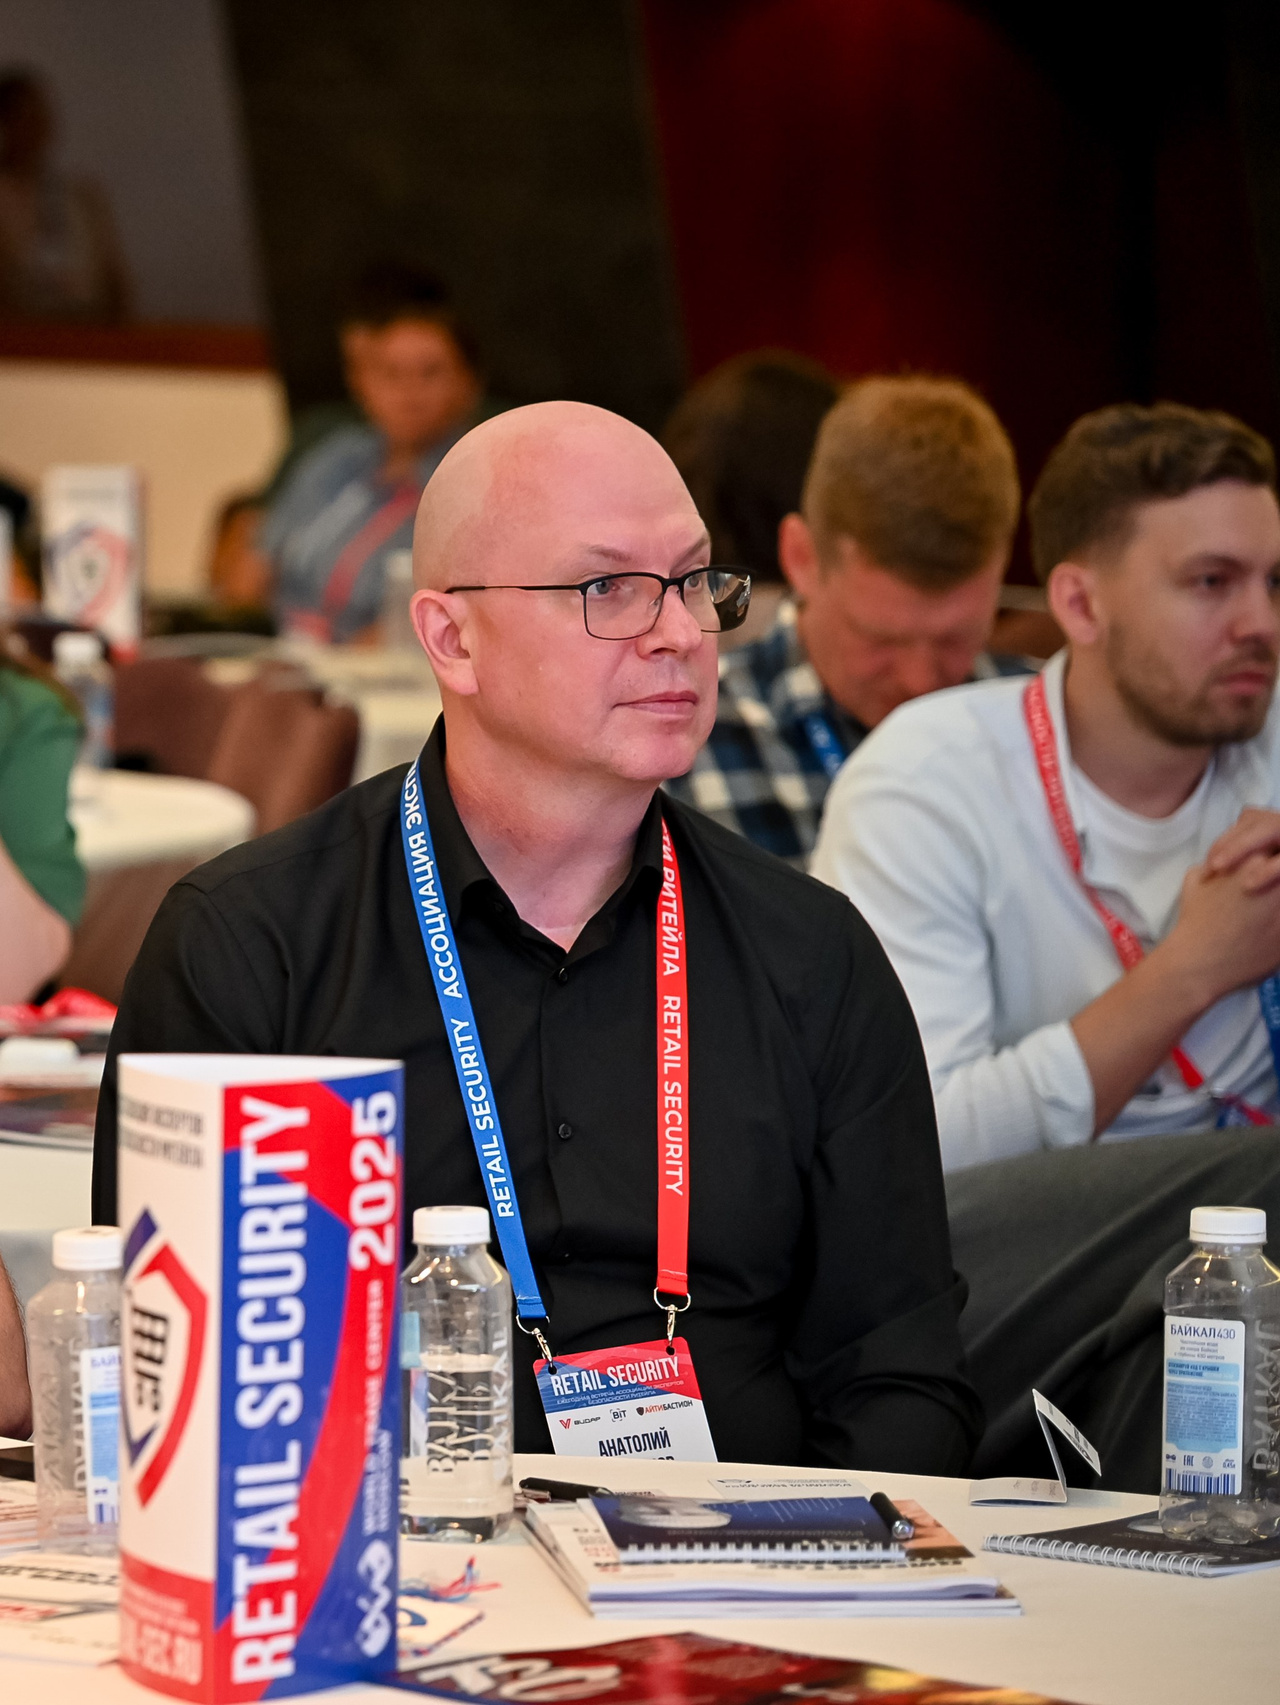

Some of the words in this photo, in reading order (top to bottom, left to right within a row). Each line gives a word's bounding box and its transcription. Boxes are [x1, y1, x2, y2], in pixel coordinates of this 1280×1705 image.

[408, 831, 463, 999] АССОЦИАЦИЯ
[661, 866, 683, 977] РИТЕЙЛА
[451, 1018, 495, 1131] SECURITY
[663, 995, 681, 1075] RETAIL
[348, 1090, 397, 1271] 2025
[481, 1135, 514, 1218] RETAIL
[664, 1081, 684, 1196] SECURITY
[234, 1094, 311, 1429] SECURITY
[550, 1367, 607, 1396] RETAIL
[607, 1356, 680, 1387] SECURITY
[645, 1400, 693, 1414] АЙТИБАСТИОН
[599, 1427, 671, 1457] АНАТОЛИЙ
[230, 1438, 302, 1684] RETAIL
